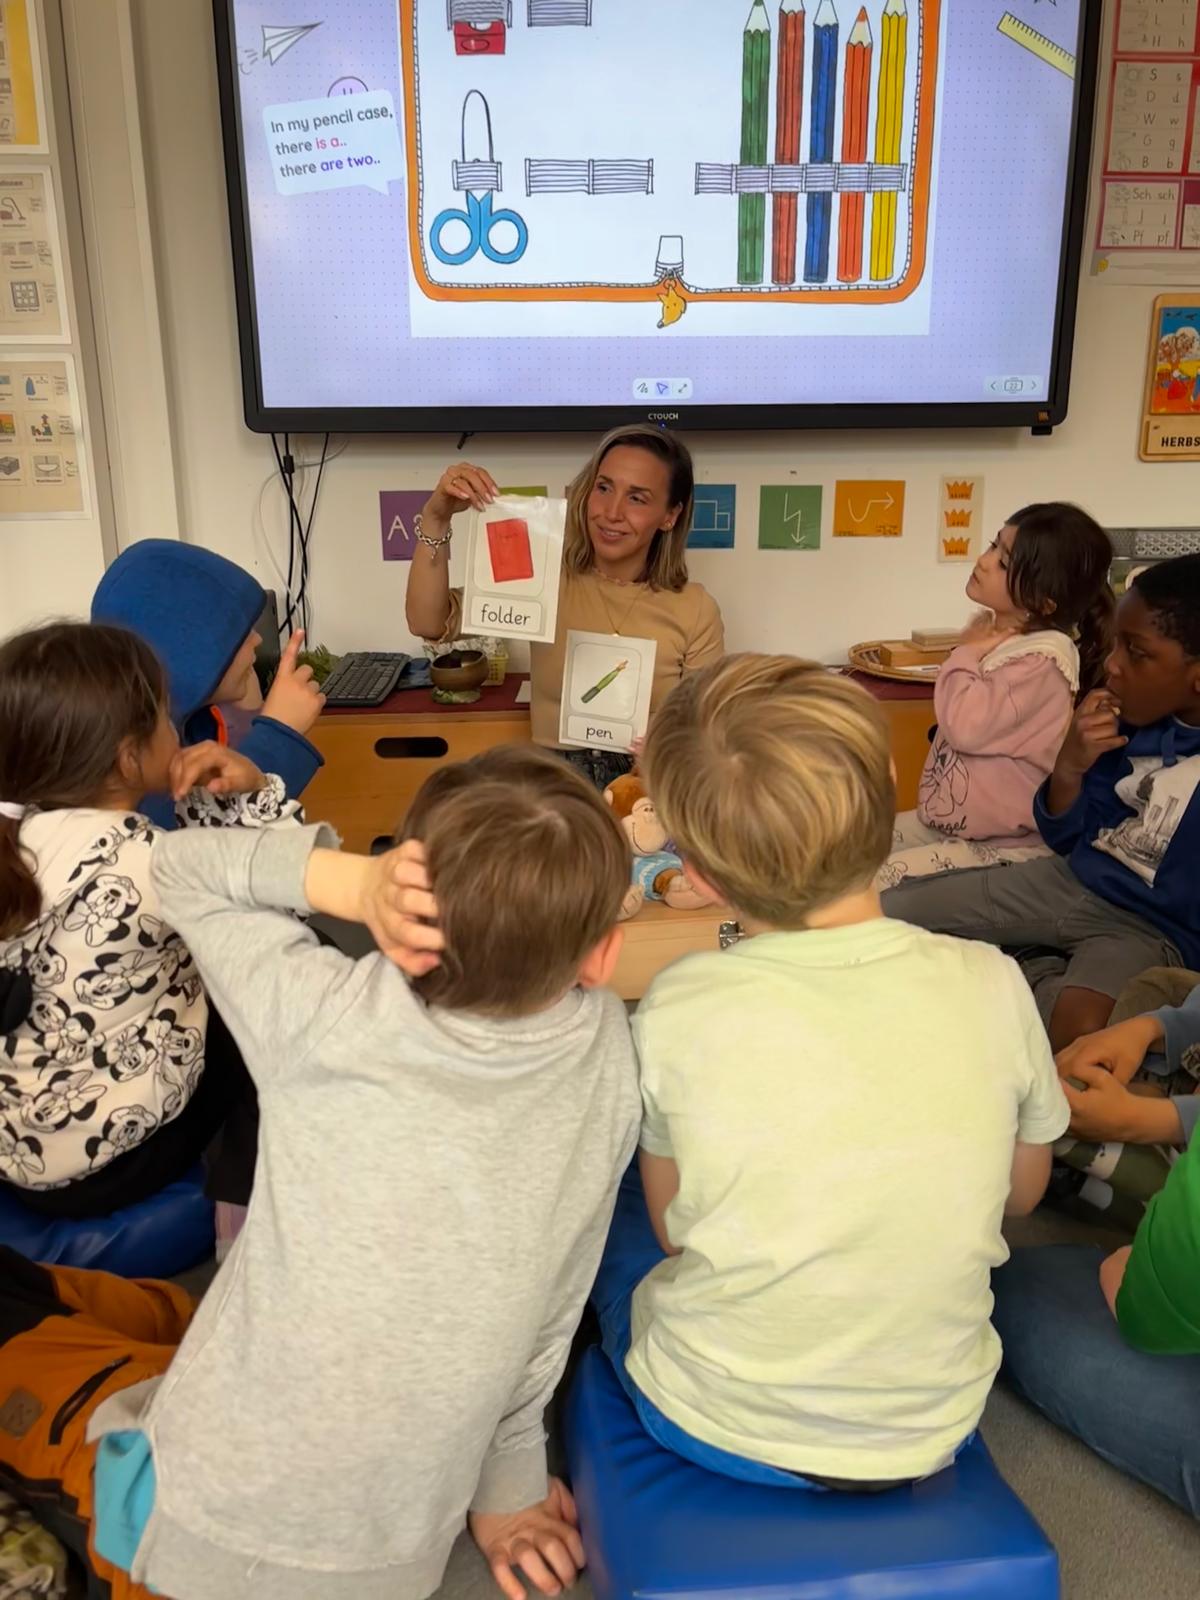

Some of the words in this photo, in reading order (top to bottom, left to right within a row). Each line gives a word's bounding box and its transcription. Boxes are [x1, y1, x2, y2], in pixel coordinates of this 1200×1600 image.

[1149, 68, 1158, 81] S
[1146, 90, 1157, 103] D
[1172, 90, 1180, 103] d
[270, 121, 284, 133] In
[287, 118, 310, 132] my
[313, 108, 354, 130] pencil
[356, 106, 393, 121] case,
[1143, 111, 1157, 125] W
[1169, 117, 1180, 125] w
[275, 140, 313, 156] there
[315, 137, 327, 149] is
[1168, 139, 1176, 151] g
[279, 162, 317, 177] there
[320, 159, 344, 171] are
[1142, 155, 1149, 168] B
[1166, 156, 1174, 168] b
[1132, 187, 1152, 200] Sch
[1158, 187, 1175, 200] sch
[1157, 230, 1171, 246] pf
[647, 412, 679, 421] CTOUCH
[481, 603, 531, 626] folder
[585, 726, 614, 740] pen
